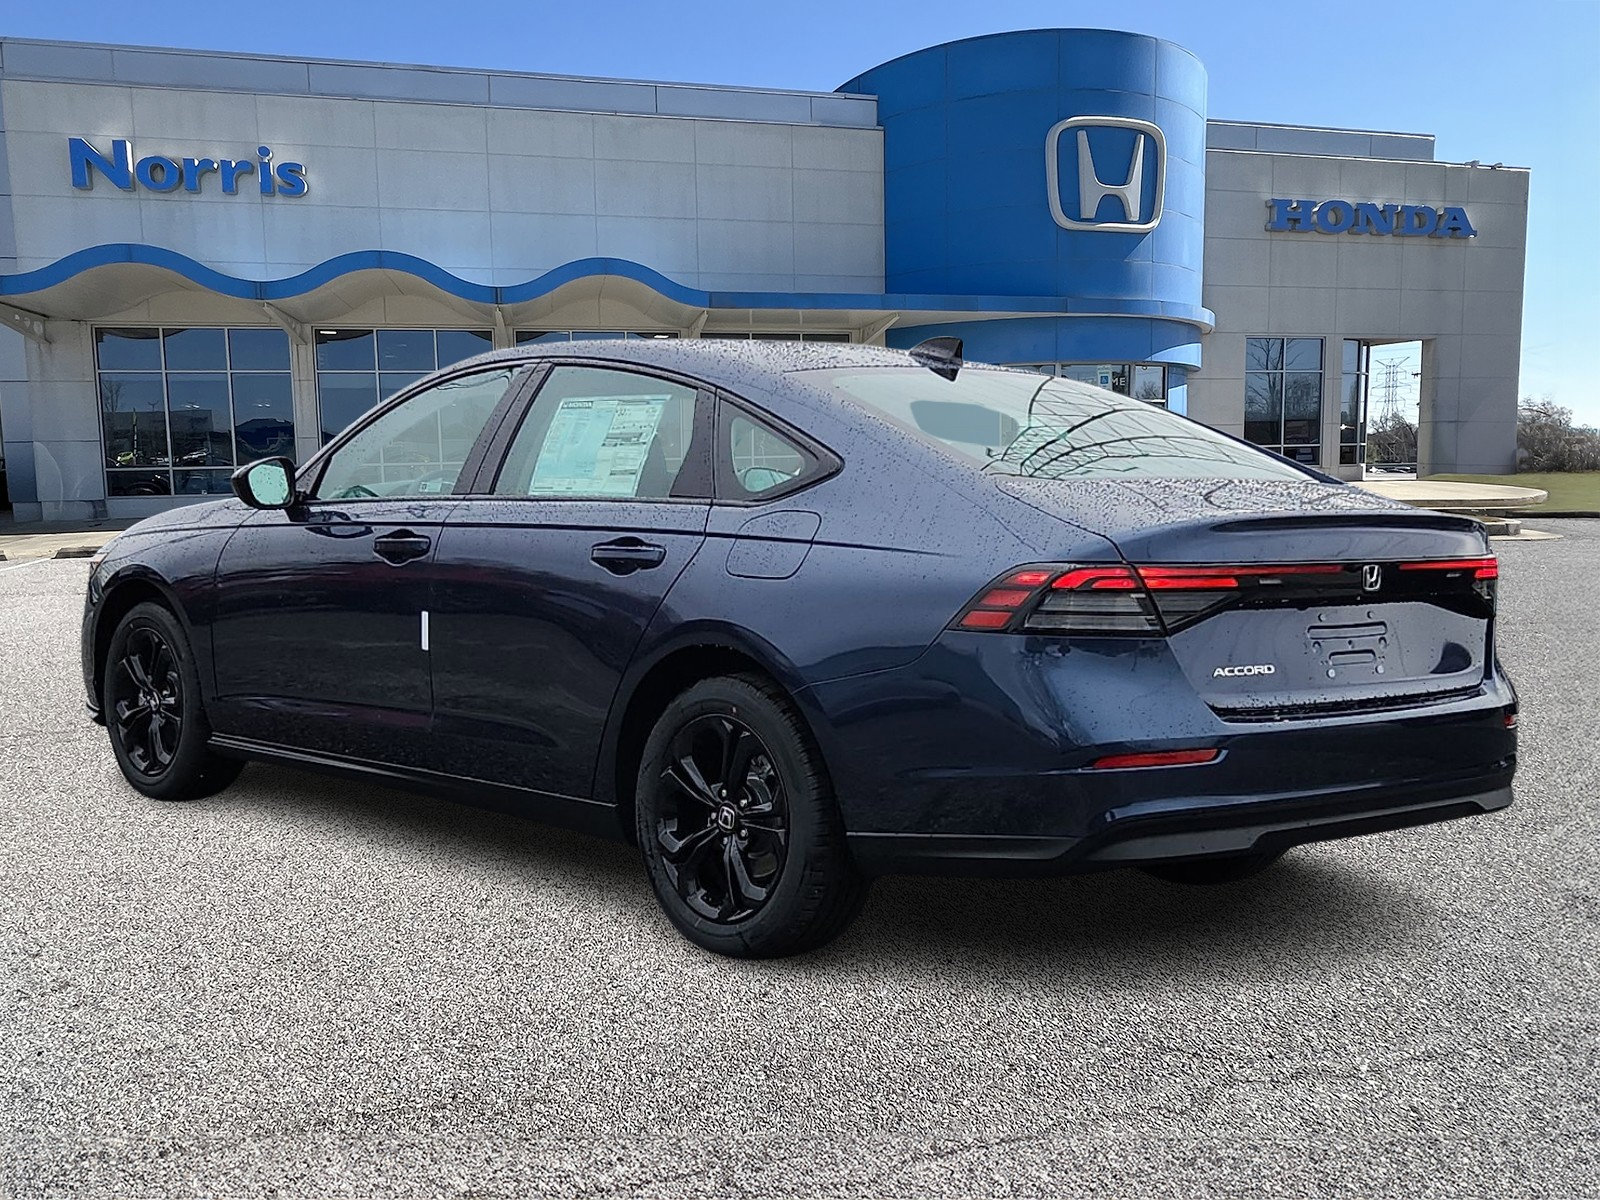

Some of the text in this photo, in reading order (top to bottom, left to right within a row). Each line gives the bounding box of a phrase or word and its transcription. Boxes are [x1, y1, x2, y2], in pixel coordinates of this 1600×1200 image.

[68, 137, 309, 197] Norris
[1265, 198, 1478, 239] HONDA
[1213, 664, 1276, 678] ACCORD
